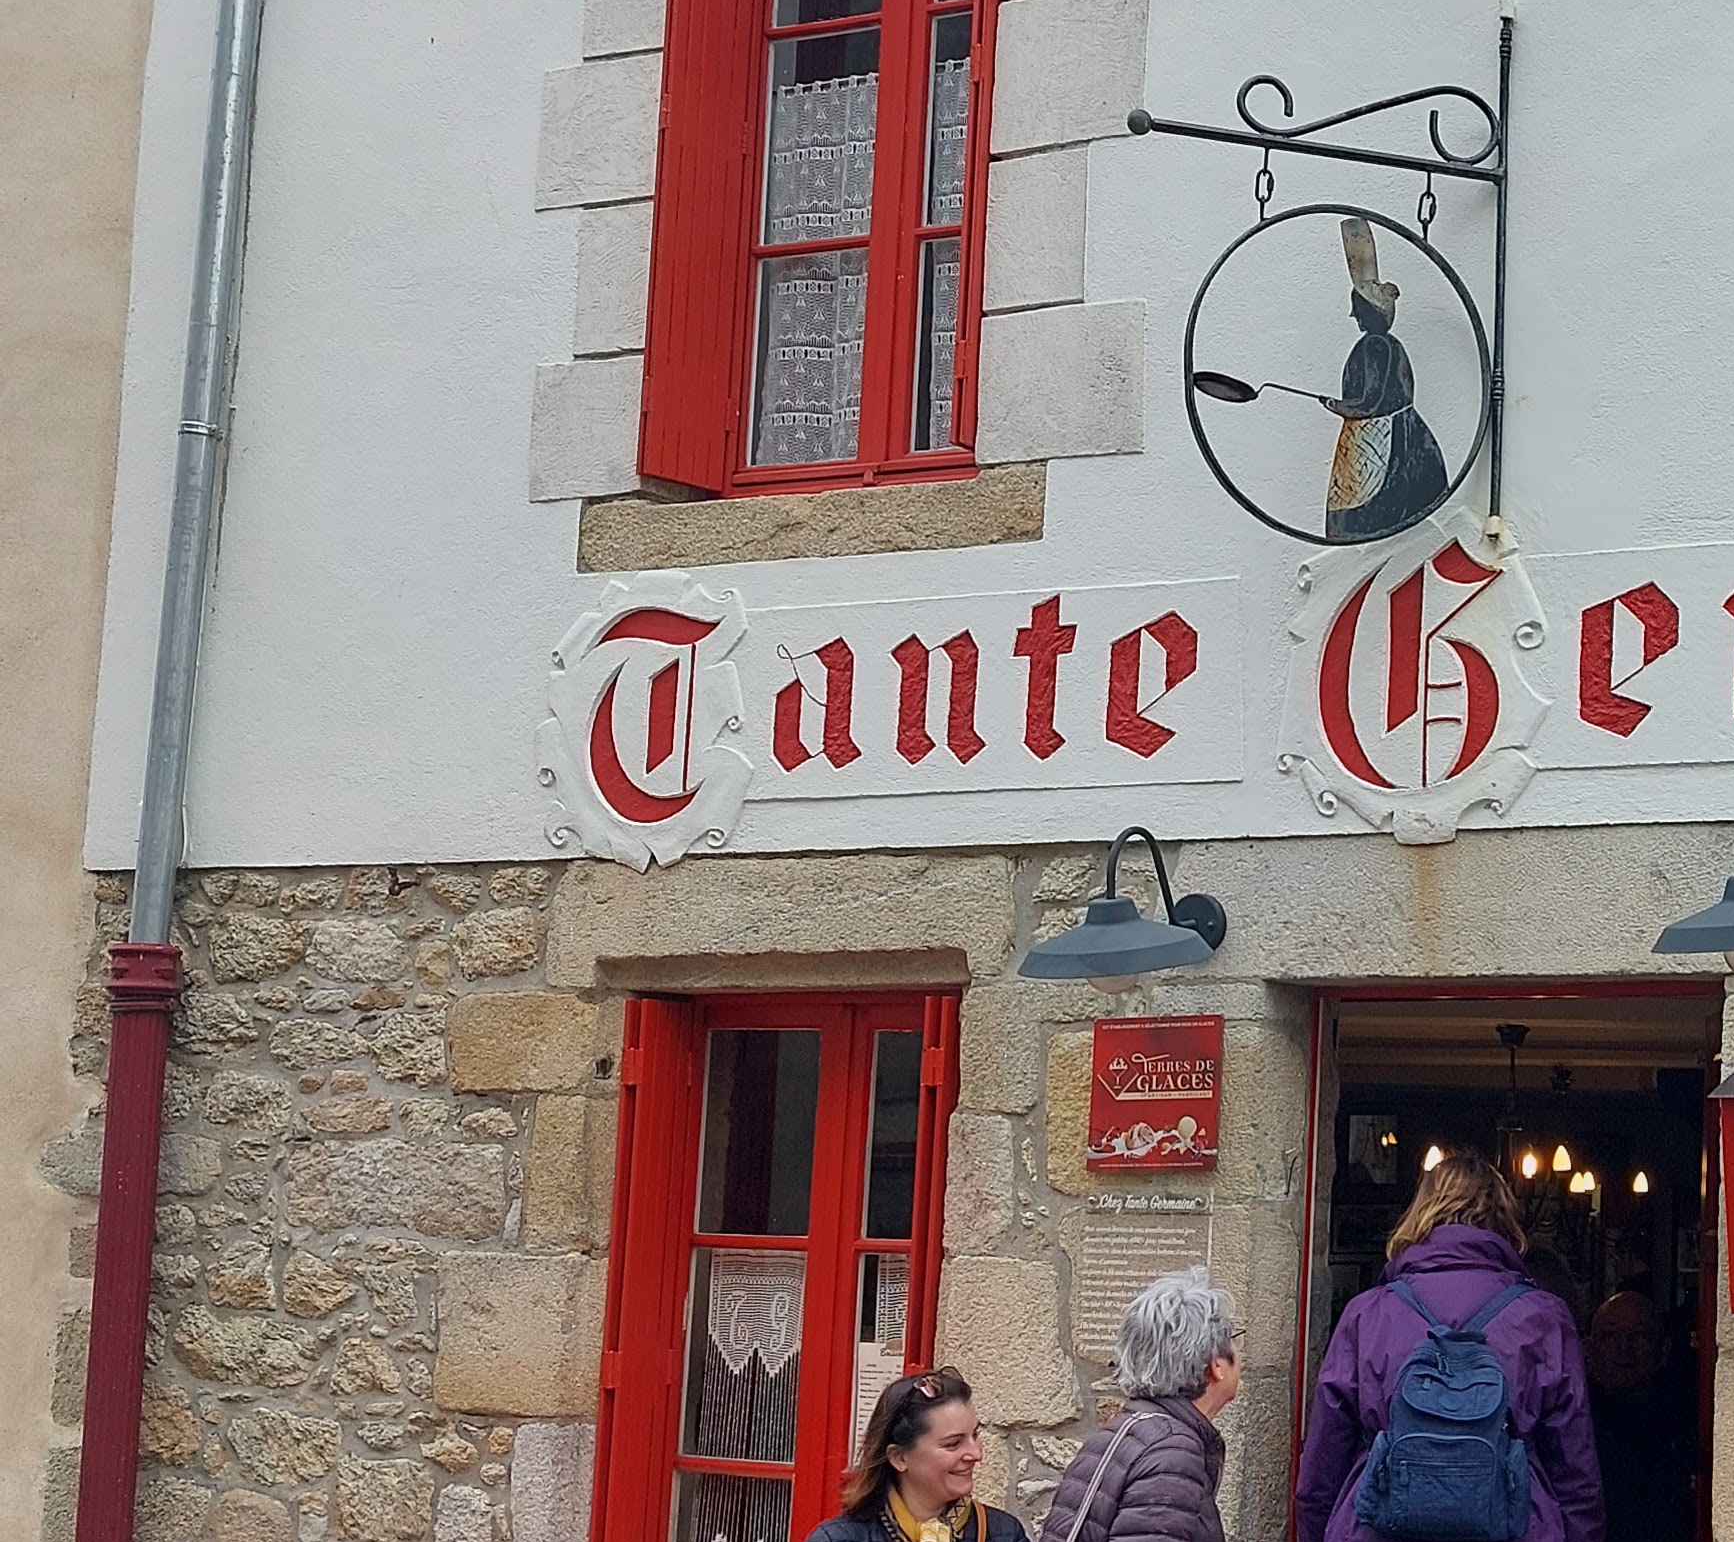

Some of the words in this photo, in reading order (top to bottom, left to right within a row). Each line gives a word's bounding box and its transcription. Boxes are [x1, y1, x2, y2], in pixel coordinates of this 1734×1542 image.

[588, 594, 1199, 824] Tante
[1131, 1053, 1191, 1074] TERRES
[1195, 1060, 1215, 1071] DE
[1136, 1073, 1214, 1092] GLACES
[1100, 1194, 1122, 1214] Chez
[1125, 1195, 1148, 1209] Tante
[1150, 1195, 1196, 1209] Germaine
